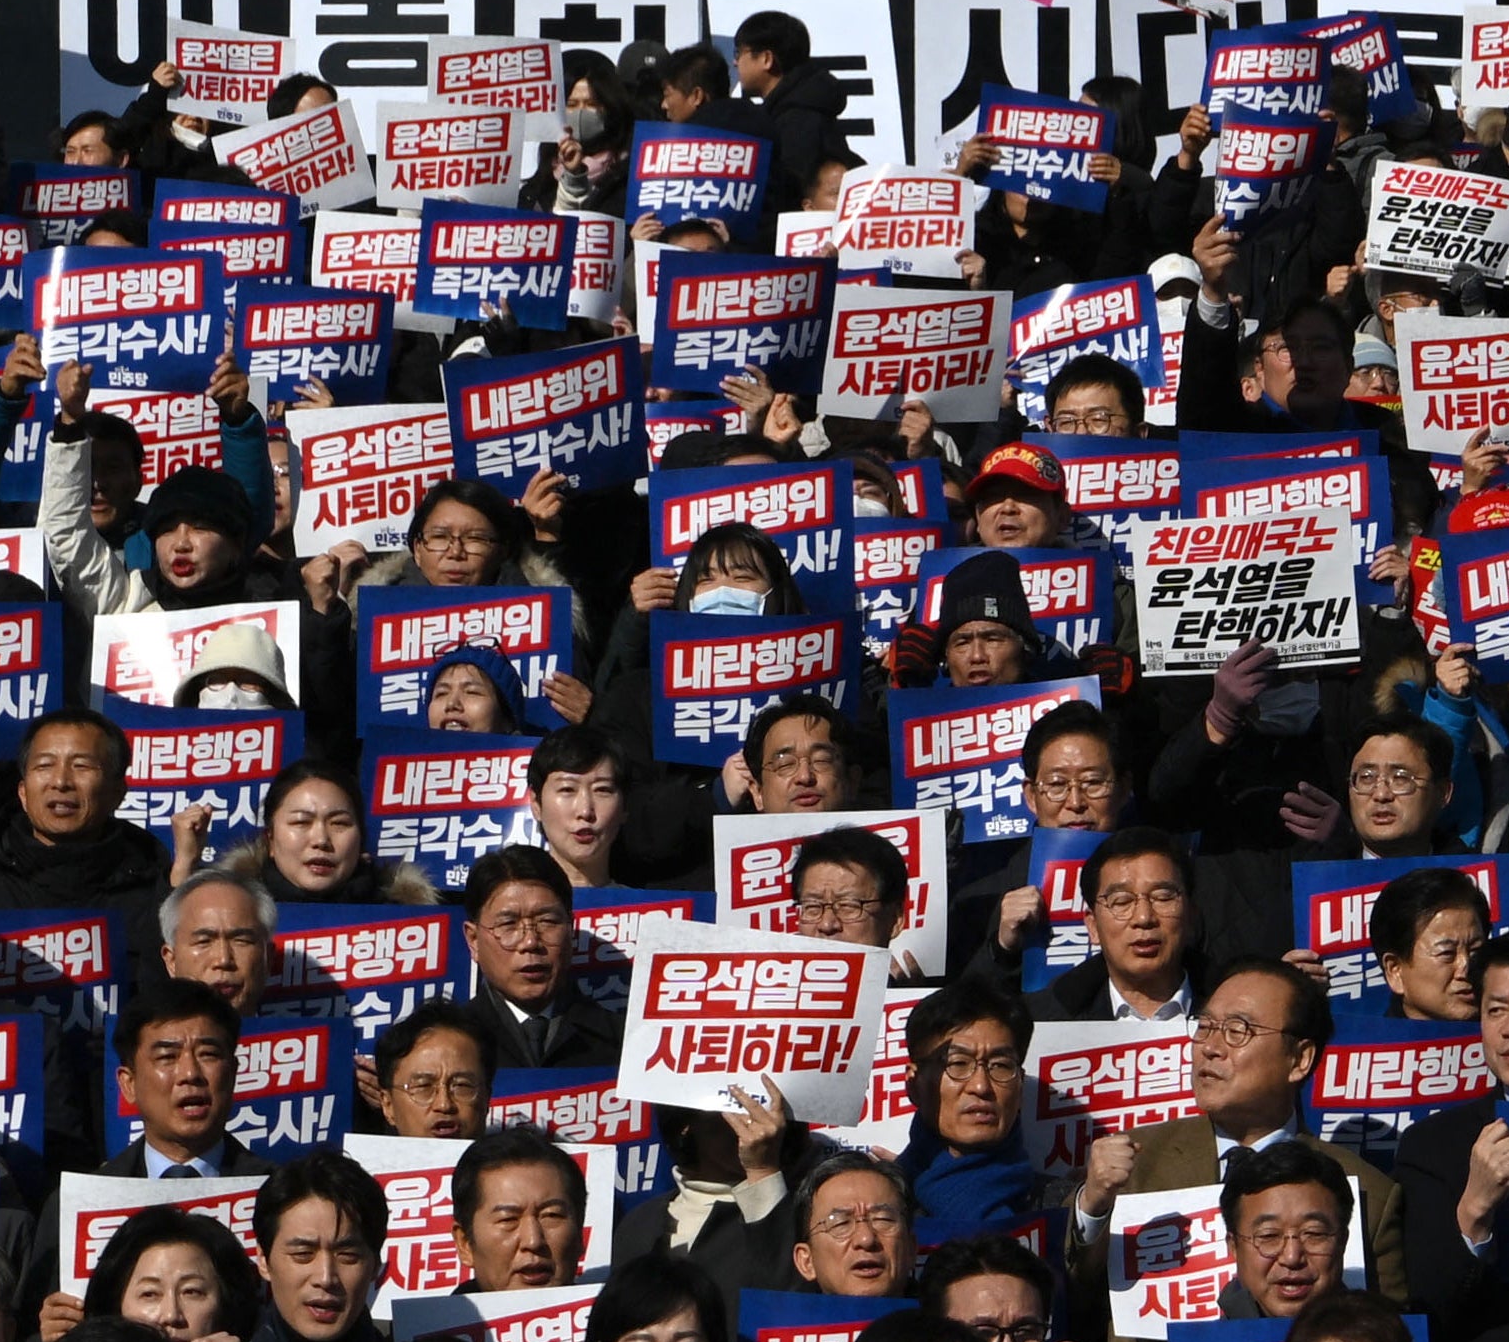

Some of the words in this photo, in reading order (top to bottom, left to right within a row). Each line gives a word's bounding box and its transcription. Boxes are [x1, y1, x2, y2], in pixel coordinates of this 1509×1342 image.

[392, 117, 503, 156] 윤석열은
[642, 142, 754, 174] 내란행위
[391, 151, 511, 189] 사퇴하라!
[638, 179, 757, 211] 즉각수사!
[1377, 196, 1495, 235] 윤석열을
[435, 224, 558, 259] 내란행위
[1387, 227, 1509, 268] 탄핵하자!
[41, 262, 198, 322] 내란행위
[431, 265, 563, 305] 즉각수사!
[250, 303, 375, 342] 내란행위
[843, 303, 984, 353] 윤석열은
[247, 344, 381, 394] 즉각수사!
[837, 350, 994, 396] 사퇴하라!
[1146, 516, 1338, 566] 친일매국노
[1148, 557, 1315, 608] 윤석열을
[1171, 596, 1352, 649] 탄핵하자!
[672, 628, 835, 694] 내란행위
[657, 959, 850, 1011] 윤석열은
[645, 1024, 862, 1074] 사퇴하라!
